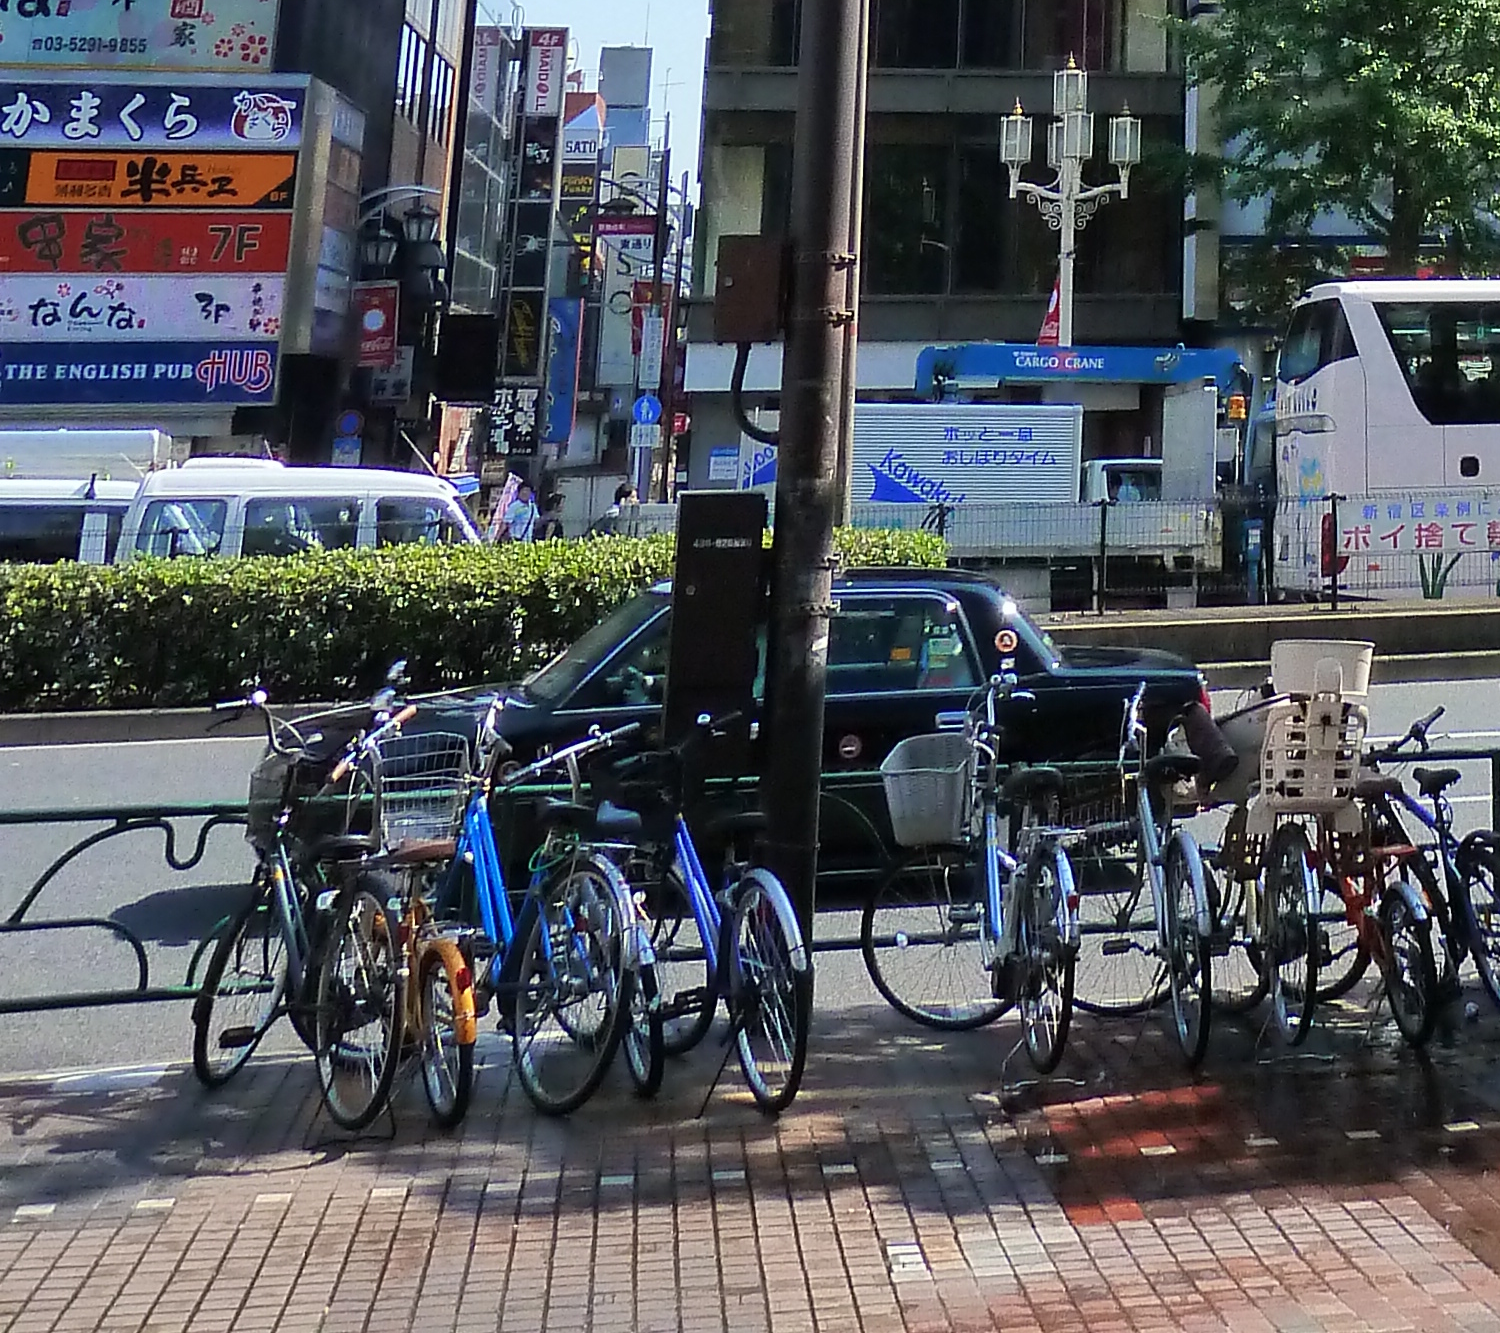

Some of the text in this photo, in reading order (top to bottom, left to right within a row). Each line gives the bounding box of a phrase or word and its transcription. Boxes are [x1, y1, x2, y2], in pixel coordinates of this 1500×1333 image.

[537, 34, 560, 46] 4F
[1, 91, 198, 140] かまくら
[565, 140, 597, 154] SATO
[208, 225, 263, 263] 7F
[28, 291, 136, 330] なんな
[194, 292, 231, 324] 3F
[4, 349, 273, 393] THE ENGLISH PUB HUB
[1015, 355, 1105, 369] CARGO CRANE
